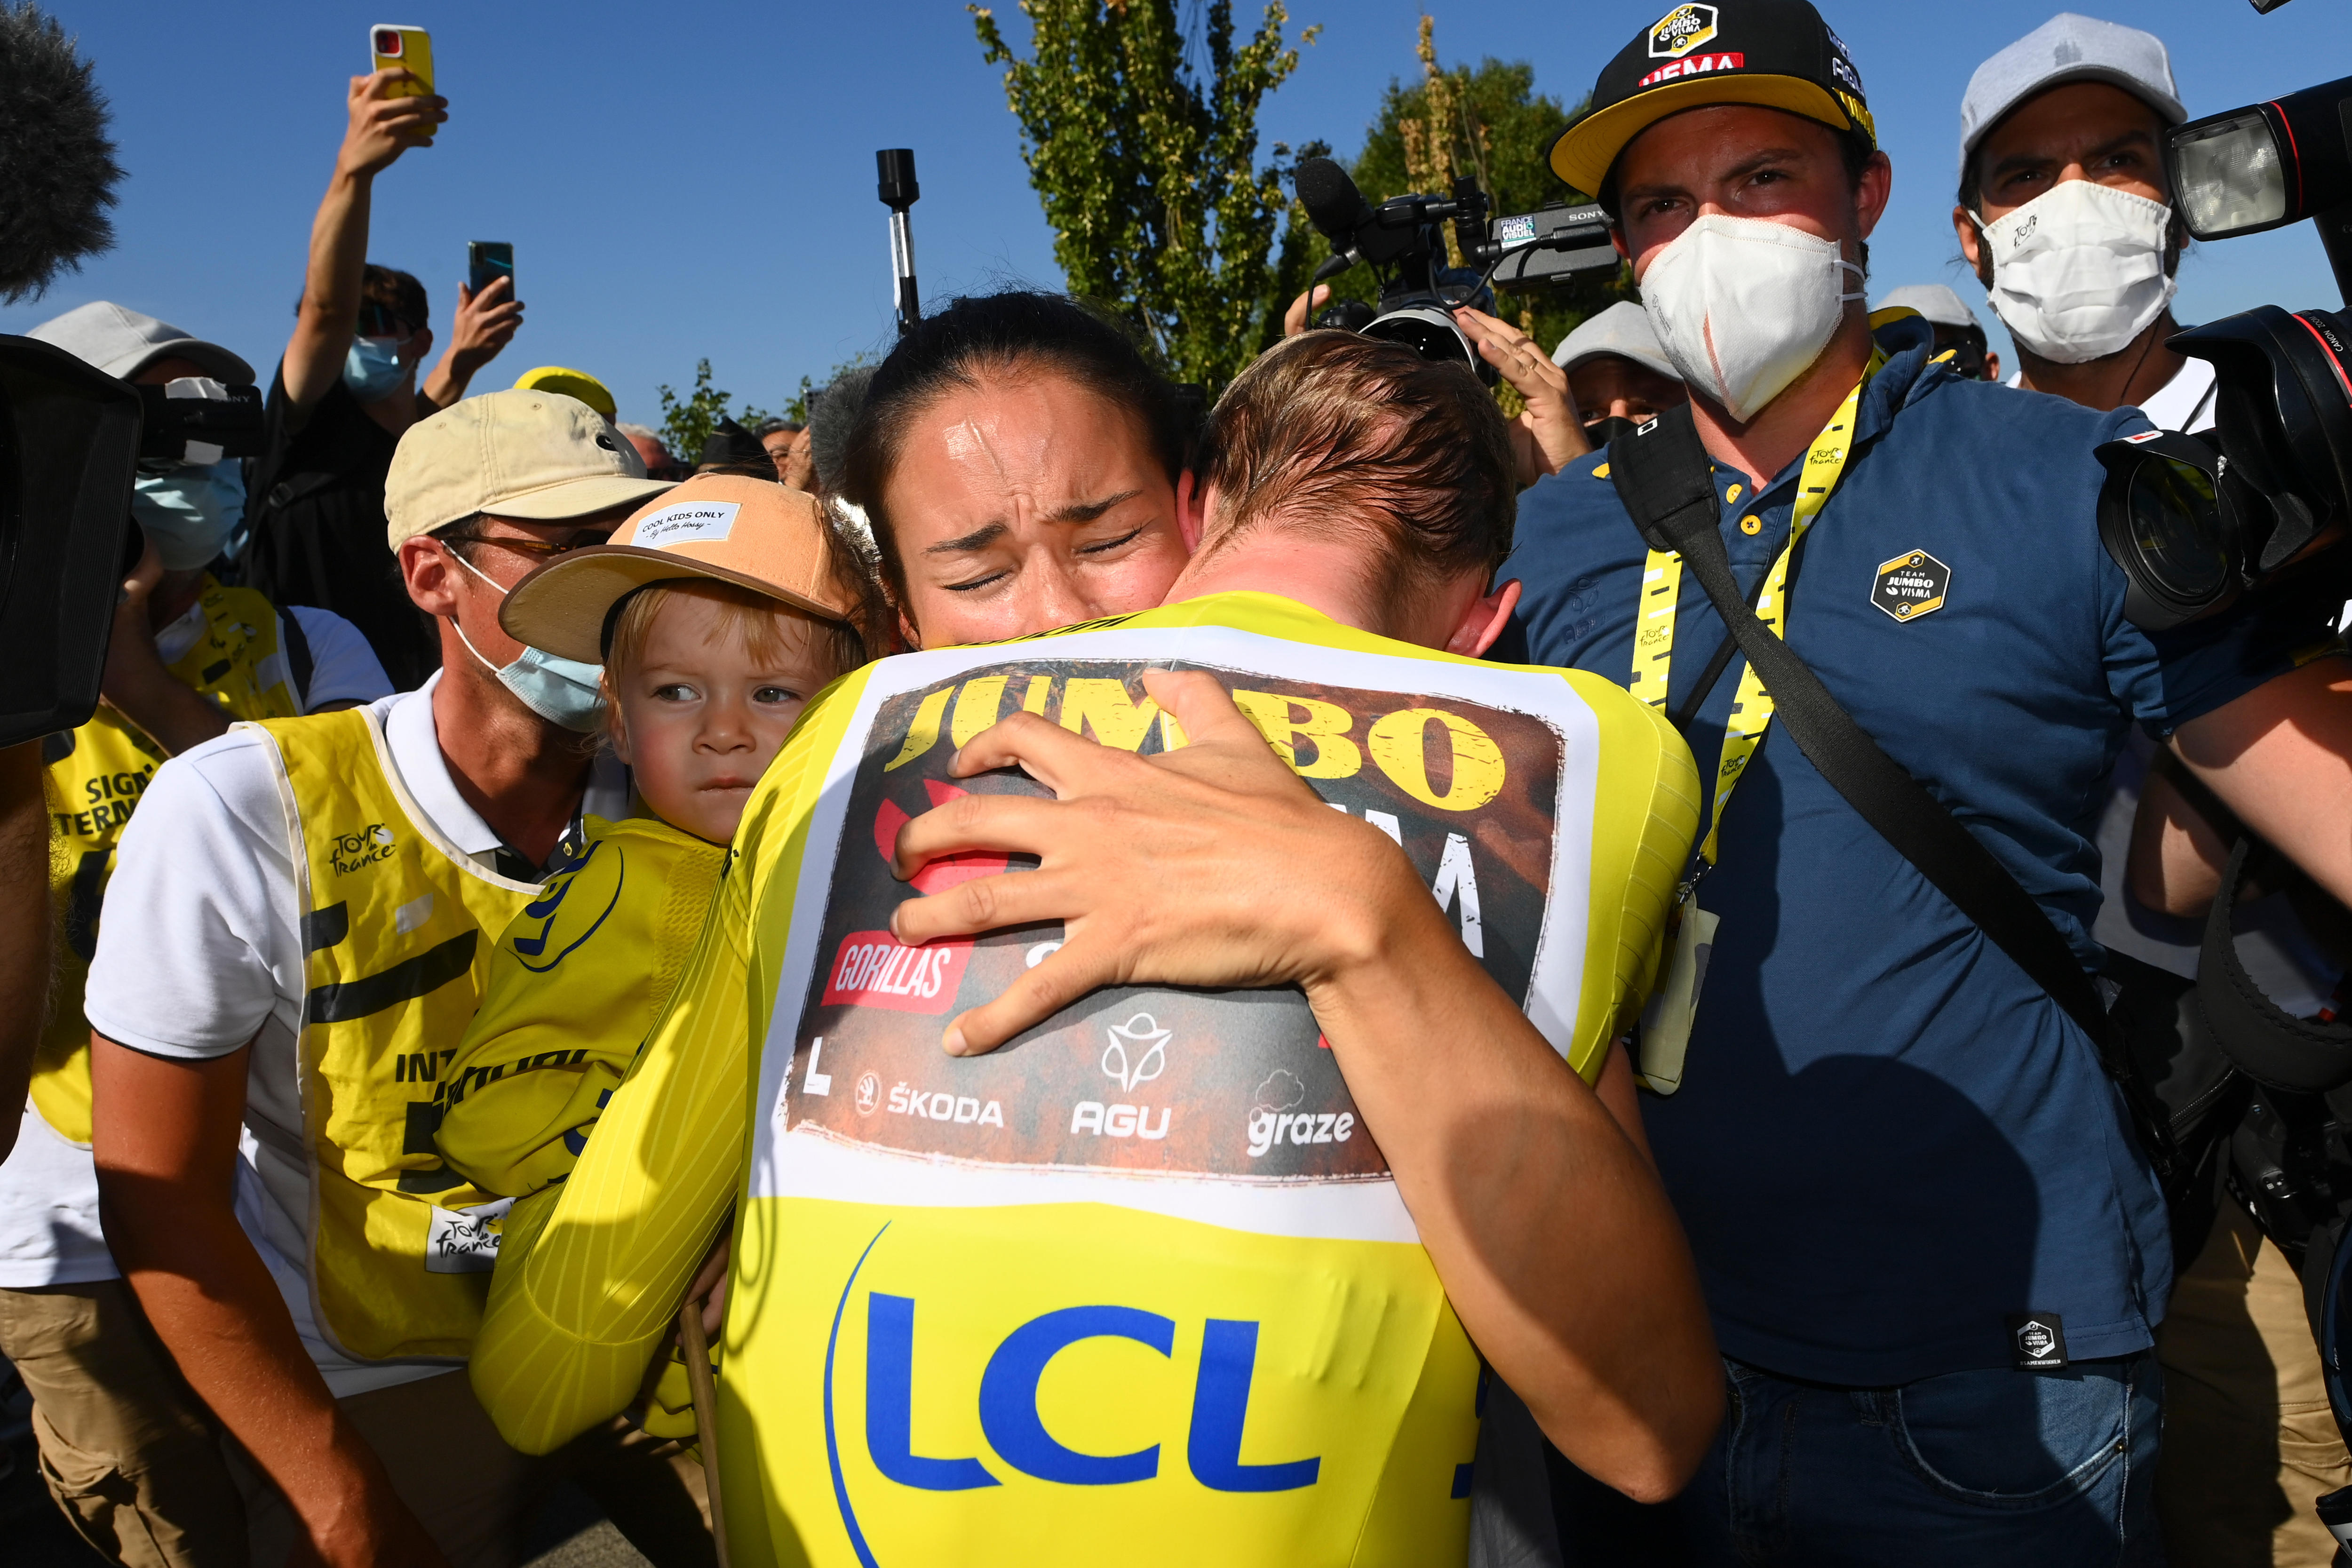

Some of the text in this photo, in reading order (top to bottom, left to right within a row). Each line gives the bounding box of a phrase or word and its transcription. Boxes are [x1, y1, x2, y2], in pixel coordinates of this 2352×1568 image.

[1661, 18, 1701, 36] JUMBO
[1671, 25, 1701, 37] VISMA
[1501, 216, 1533, 227] FRANCE
[1569, 211, 1605, 221] SONY
[1502, 230, 1534, 239] VISUEL
[2309, 316, 2344, 352] CANON ZOOM
[643, 518, 664, 533] COOL
[667, 512, 692, 523] KIDS
[650, 529, 660, 539] By
[660, 522, 679, 533] Hello
[1887, 577, 1934, 588] JUMBO
[1901, 587, 1930, 598] VISMA
[884, 675, 1506, 812] JUMBO
[369, 842, 378, 851] de
[330, 845, 396, 878] france
[835, 944, 951, 999] GORILLAS
[887, 1082, 1004, 1128] ŠKODA
[1071, 1101, 1171, 1140] AGU
[1247, 1108, 1354, 1158] graze
[479, 1232, 489, 1241] de
[866, 1290, 1321, 1493] LCL
